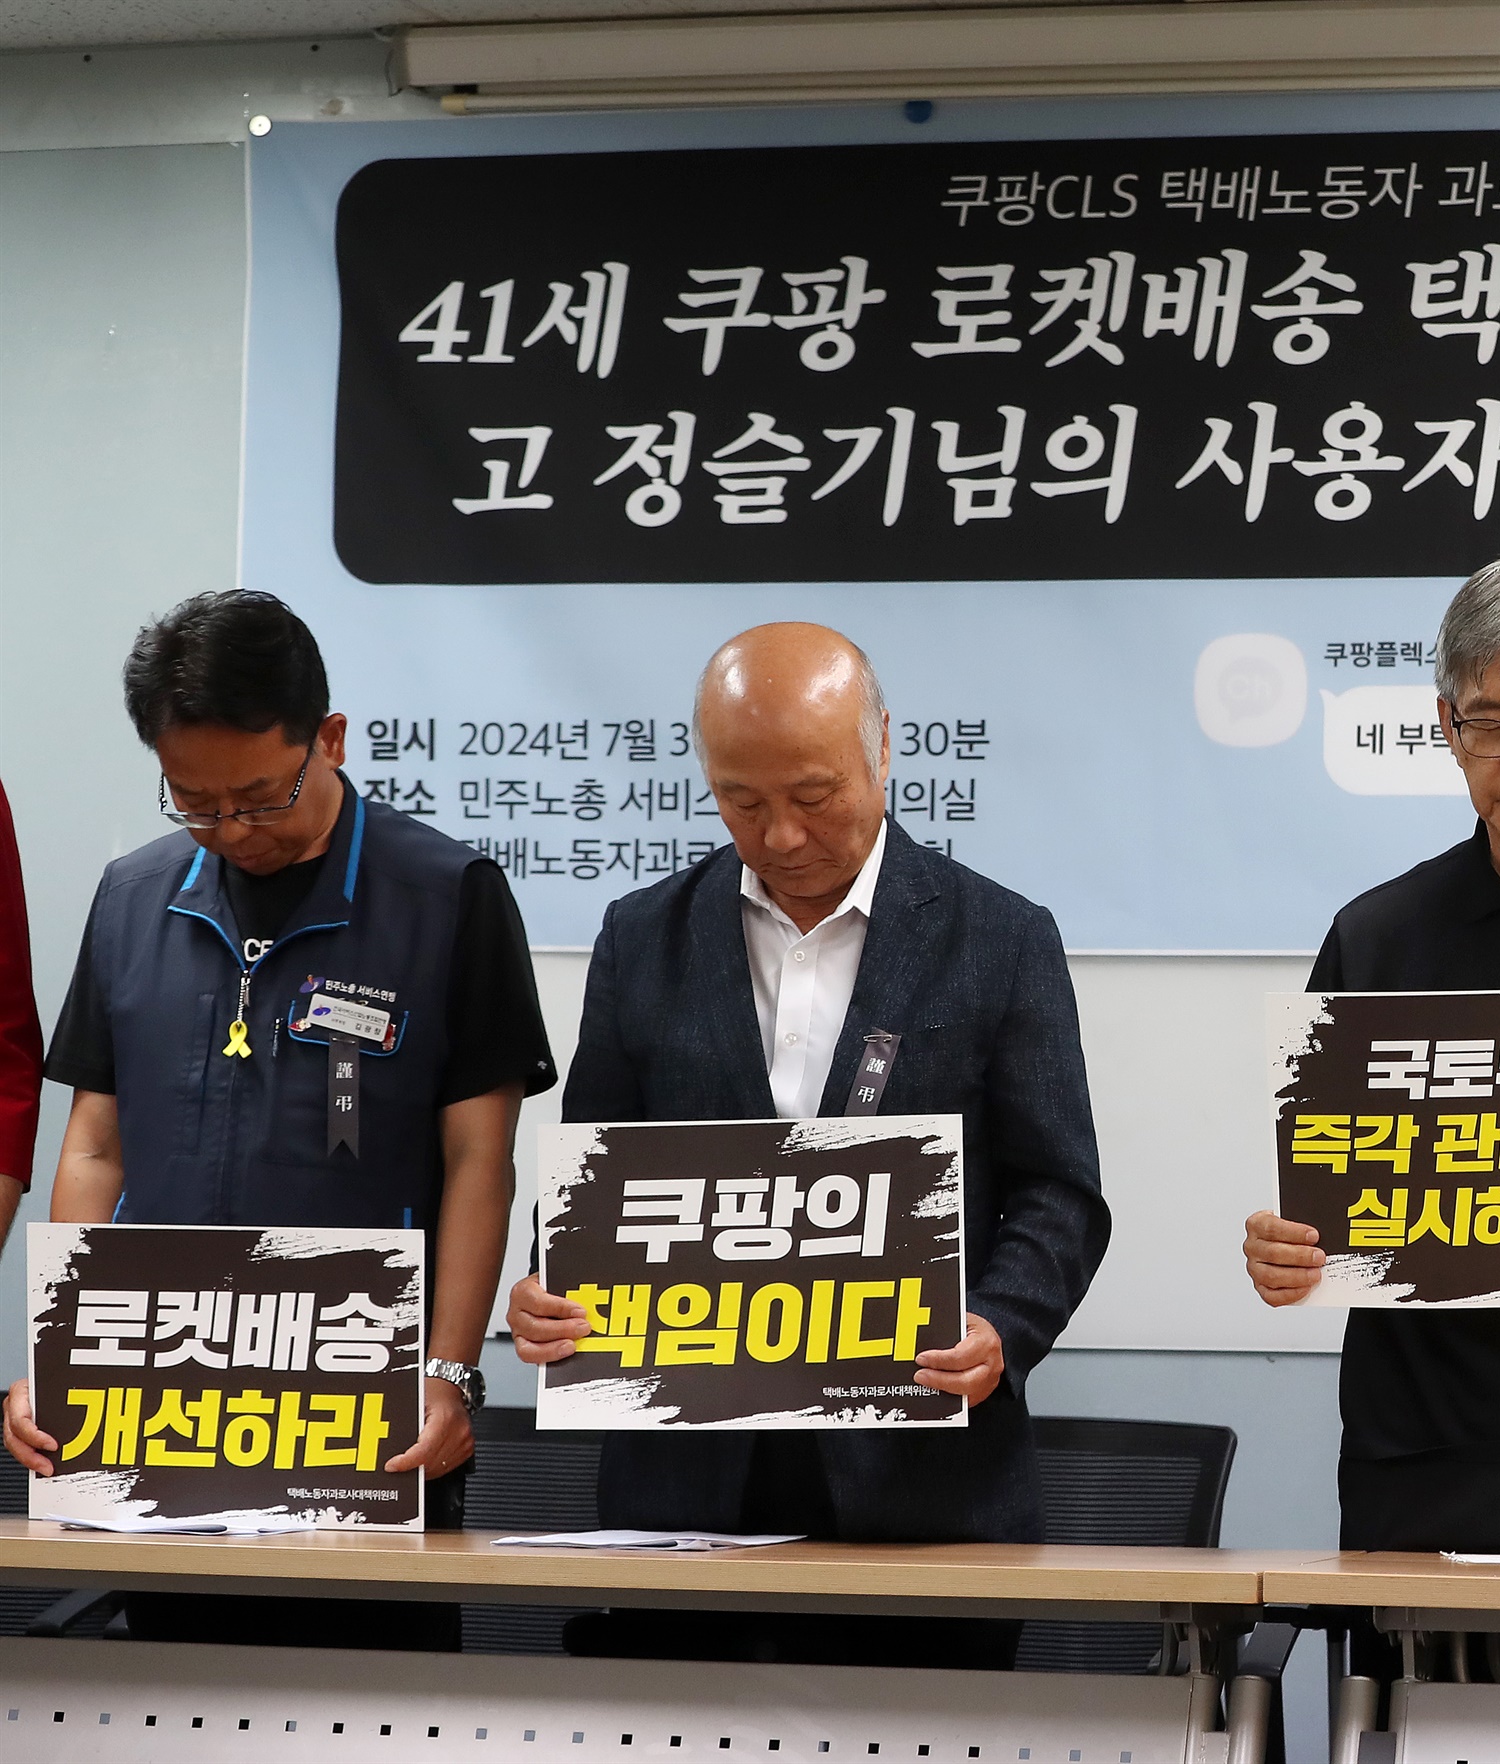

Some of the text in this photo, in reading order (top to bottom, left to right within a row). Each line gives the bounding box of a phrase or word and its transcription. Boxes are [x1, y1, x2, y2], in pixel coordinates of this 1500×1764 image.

[941, 171, 1138, 227] 쿠팡CLS
[1161, 162, 1424, 223] 택배노동자
[399, 261, 629, 379] 41세
[663, 256, 886, 376] 쿠팡
[911, 248, 1364, 368] 로켓배송
[452, 425, 554, 515] 고
[593, 403, 1139, 528] 정슬기님의
[367, 718, 435, 761] 일시
[460, 719, 588, 761] 2024년
[602, 718, 657, 762] 7월
[899, 719, 990, 761] 30분
[1357, 723, 1384, 755] 네
[460, 778, 607, 821] 민주노총
[1292, 1114, 1419, 1174] 즉각
[615, 1172, 892, 1263] 쿠팡의
[69, 1290, 395, 1373] 로켓배송
[565, 1277, 931, 1368] 책임이다
[61, 1387, 390, 1472] 개선하라
[286, 1487, 399, 1502] 택배노동자과로사대책위원회
